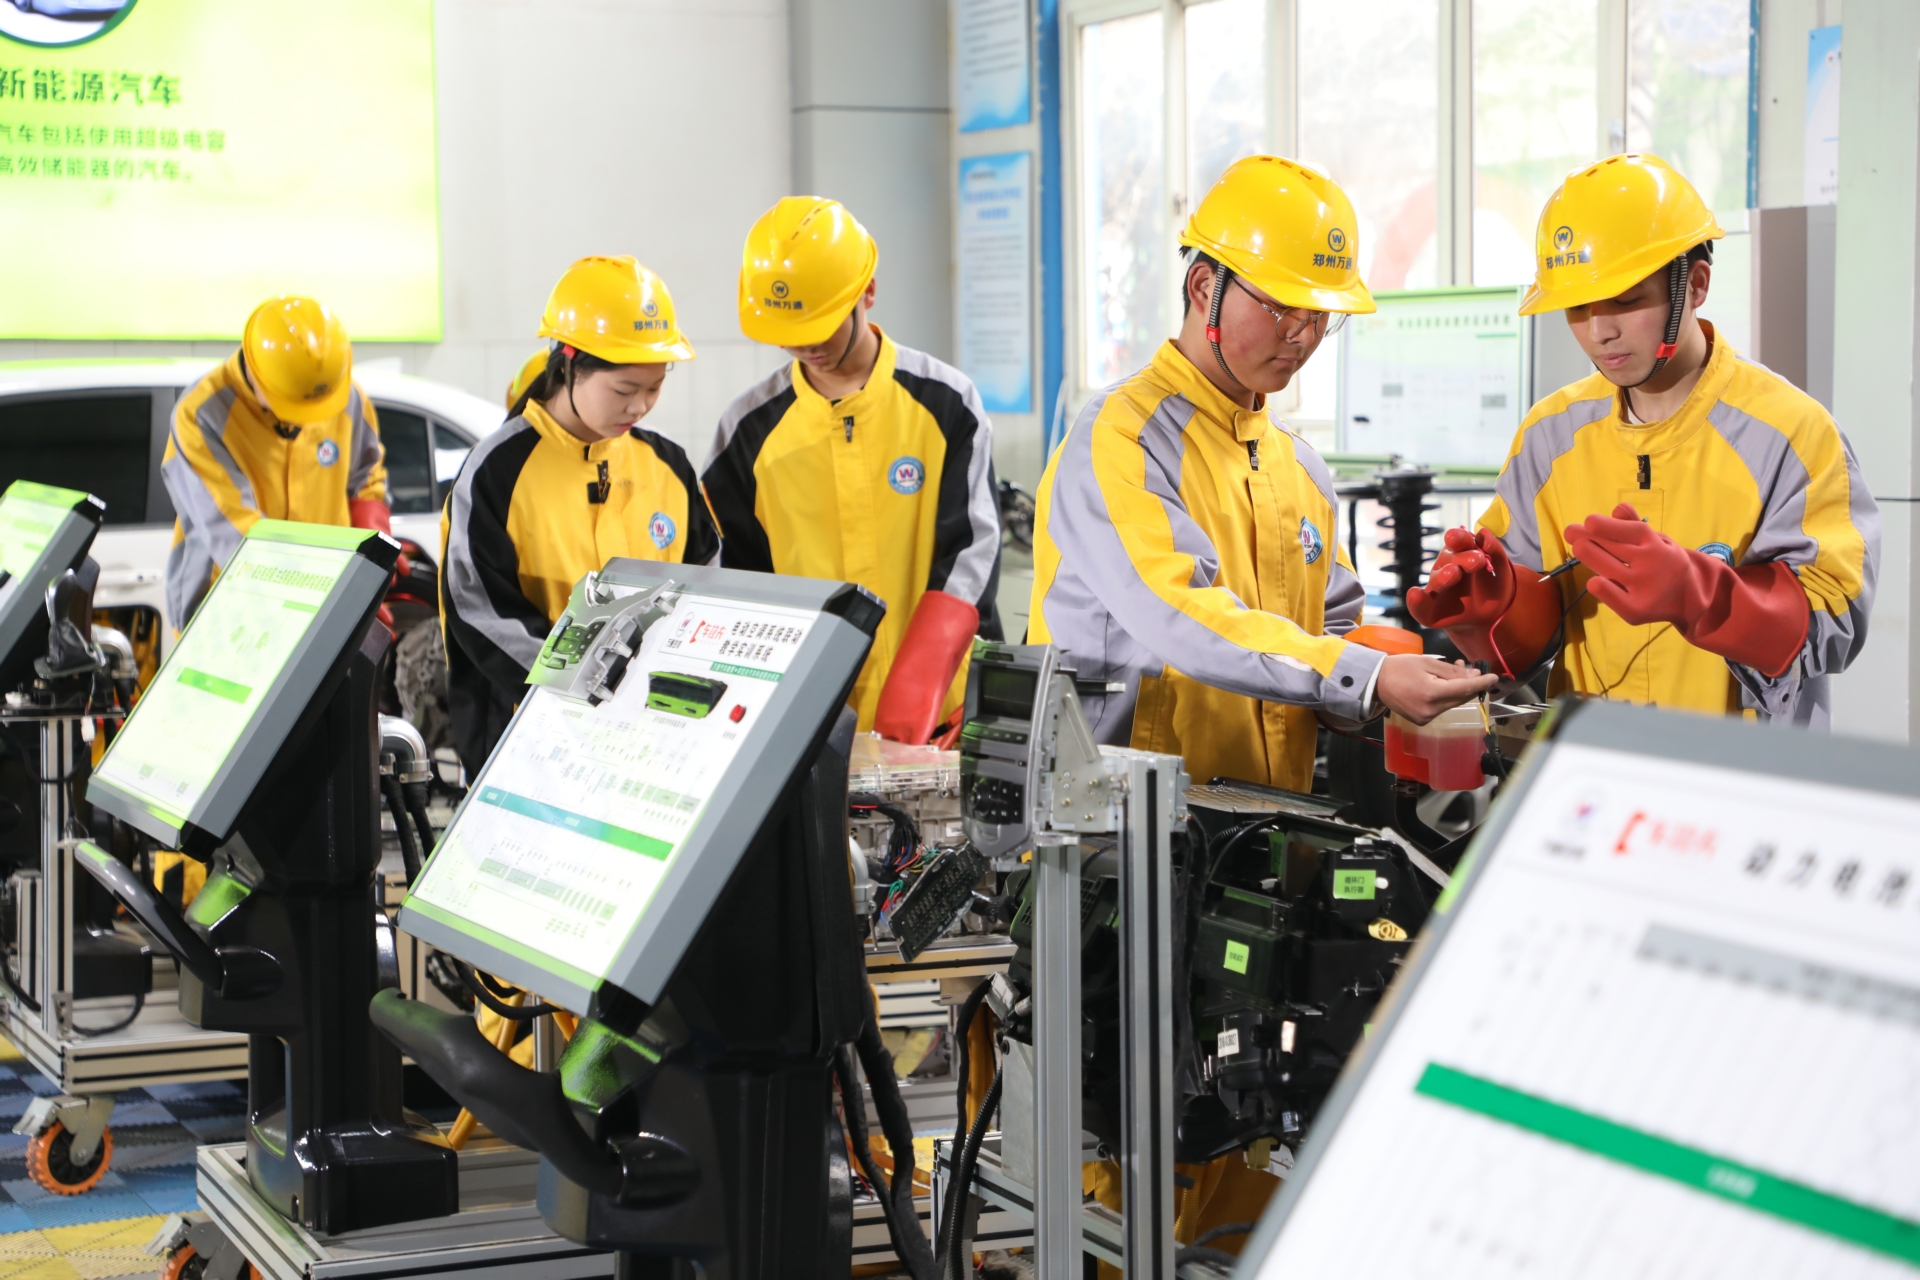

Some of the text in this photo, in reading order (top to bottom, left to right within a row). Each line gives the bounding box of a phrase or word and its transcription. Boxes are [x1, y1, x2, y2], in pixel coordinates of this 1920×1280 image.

[0, 67, 182, 108] 新能源汽车
